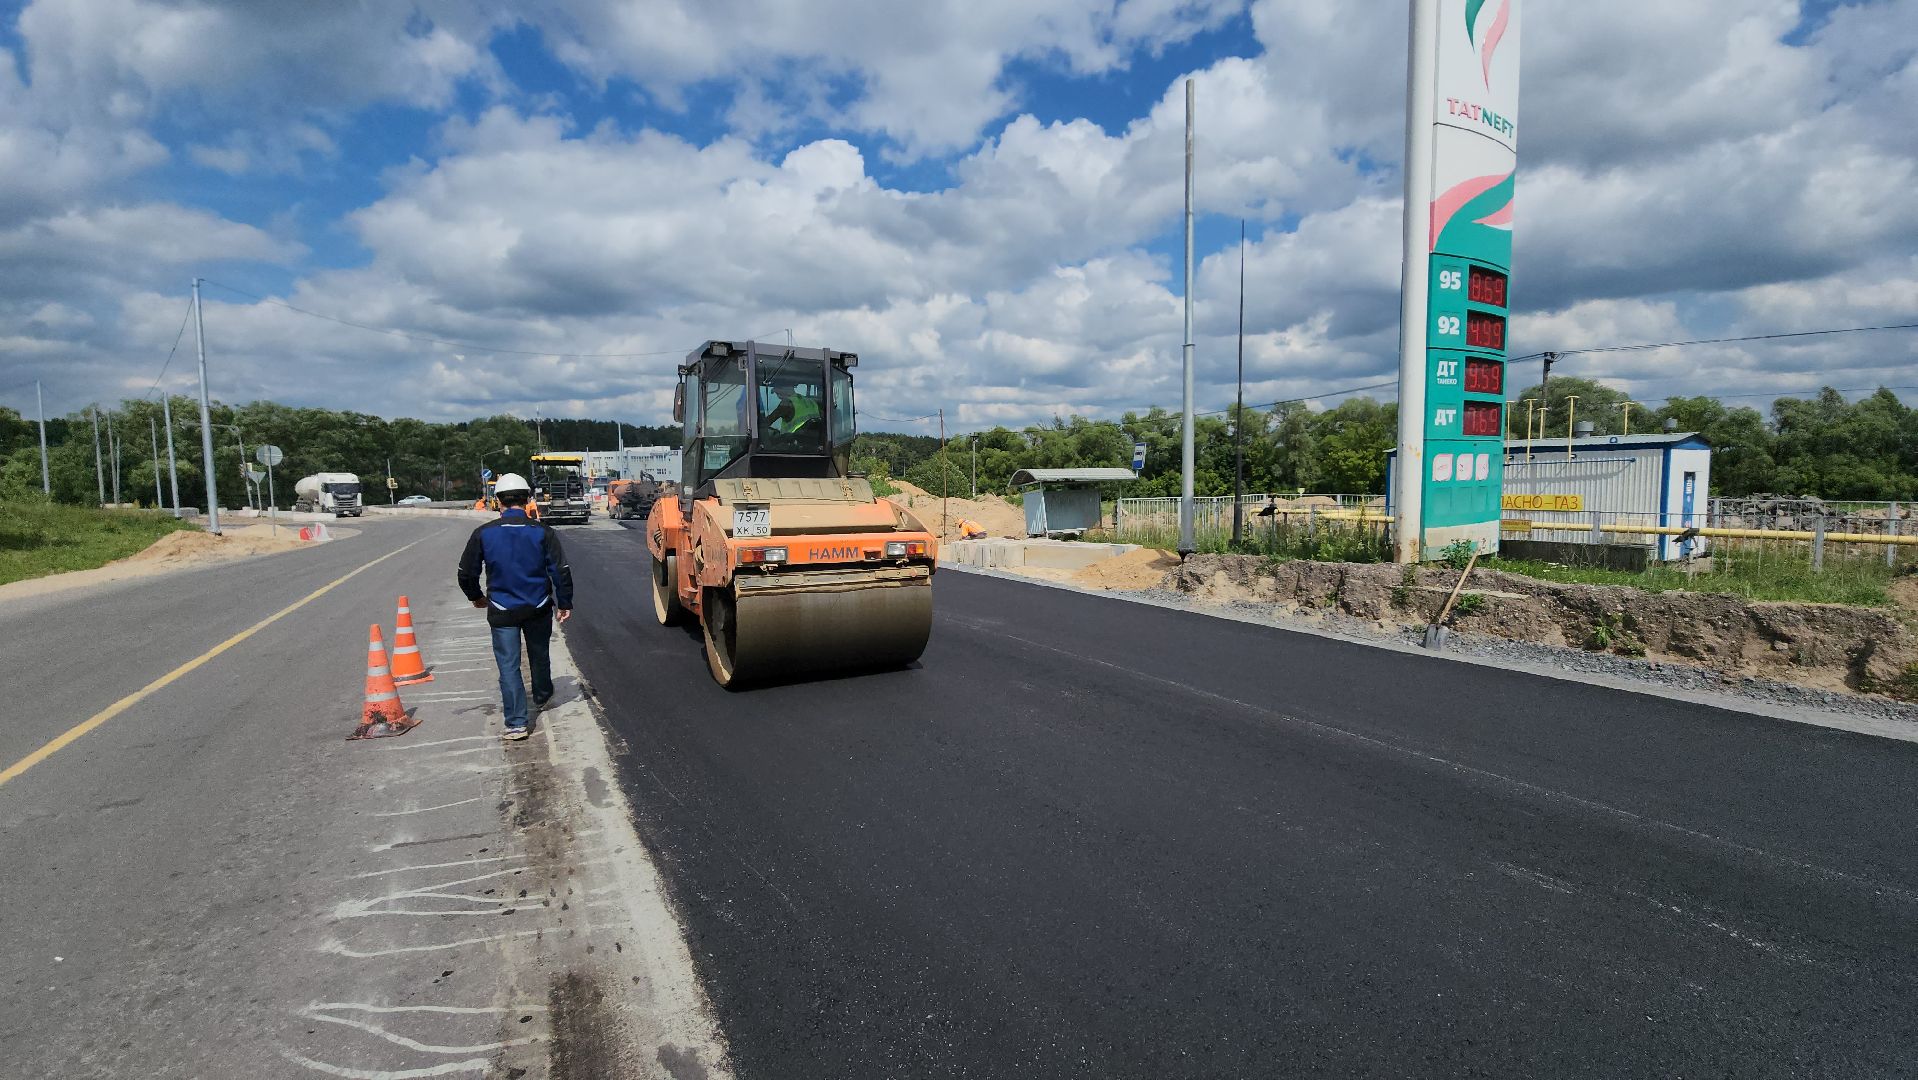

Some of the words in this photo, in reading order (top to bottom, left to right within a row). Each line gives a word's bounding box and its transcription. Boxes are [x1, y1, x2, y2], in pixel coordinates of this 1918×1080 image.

[1447, 98, 1514, 138] TATNEFT
[1440, 270, 1461, 290] 95
[1438, 316, 1460, 335] 92
[1436, 361, 1458, 377] ДТ
[1434, 409, 1456, 426] ДТ
[738, 511, 766, 523] 7577
[736, 526, 750, 535] ХК
[756, 526, 768, 535] 50
[809, 546, 859, 560] HAMM
